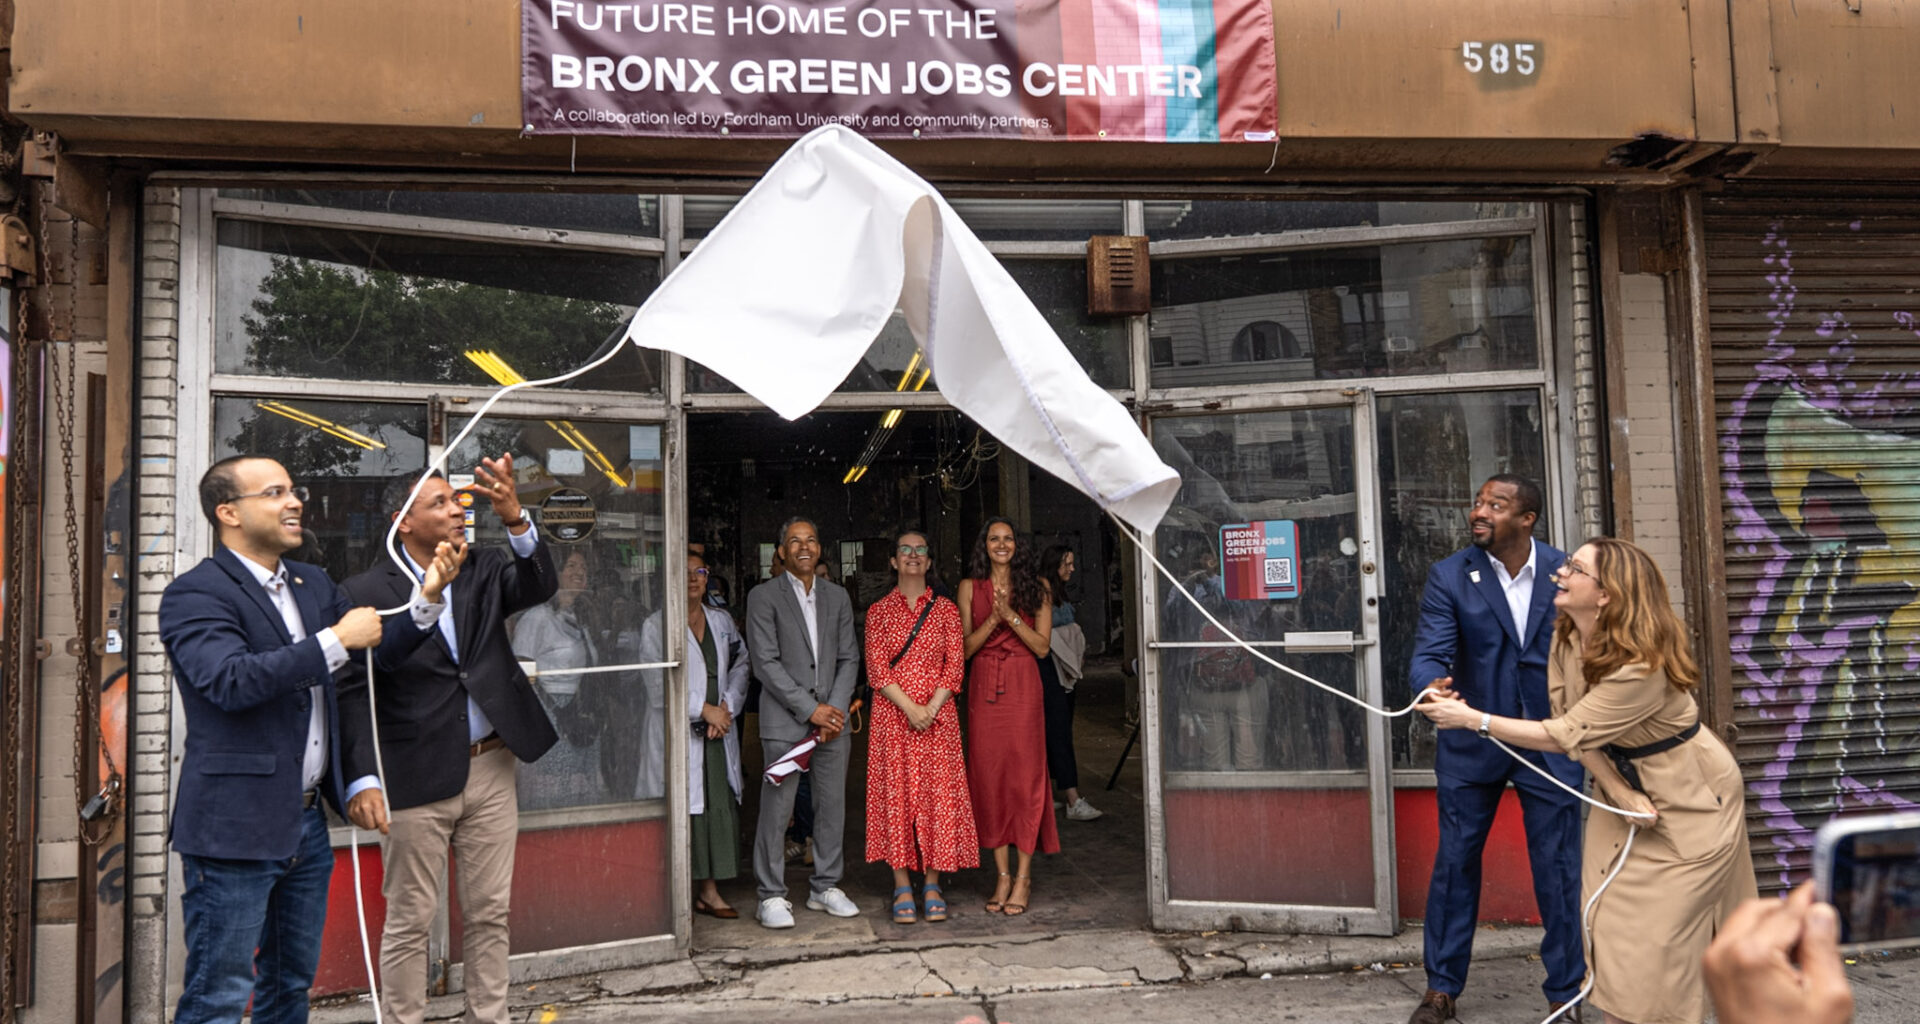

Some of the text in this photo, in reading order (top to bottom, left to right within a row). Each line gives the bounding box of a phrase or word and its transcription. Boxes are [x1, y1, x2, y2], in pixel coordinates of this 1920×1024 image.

[551, 0, 998, 40] FUTURE HOME OF THE
[1463, 41, 1535, 75] 585
[551, 53, 1203, 98] BRONX GREEN JOBS CENTER
[553, 108, 1052, 129] A collaboration led by Fordham University and community partners.
[1225, 530, 1260, 539] BRONX
[1226, 537, 1286, 547] GREEN JOBS
[1226, 546, 1267, 556] CENTER
